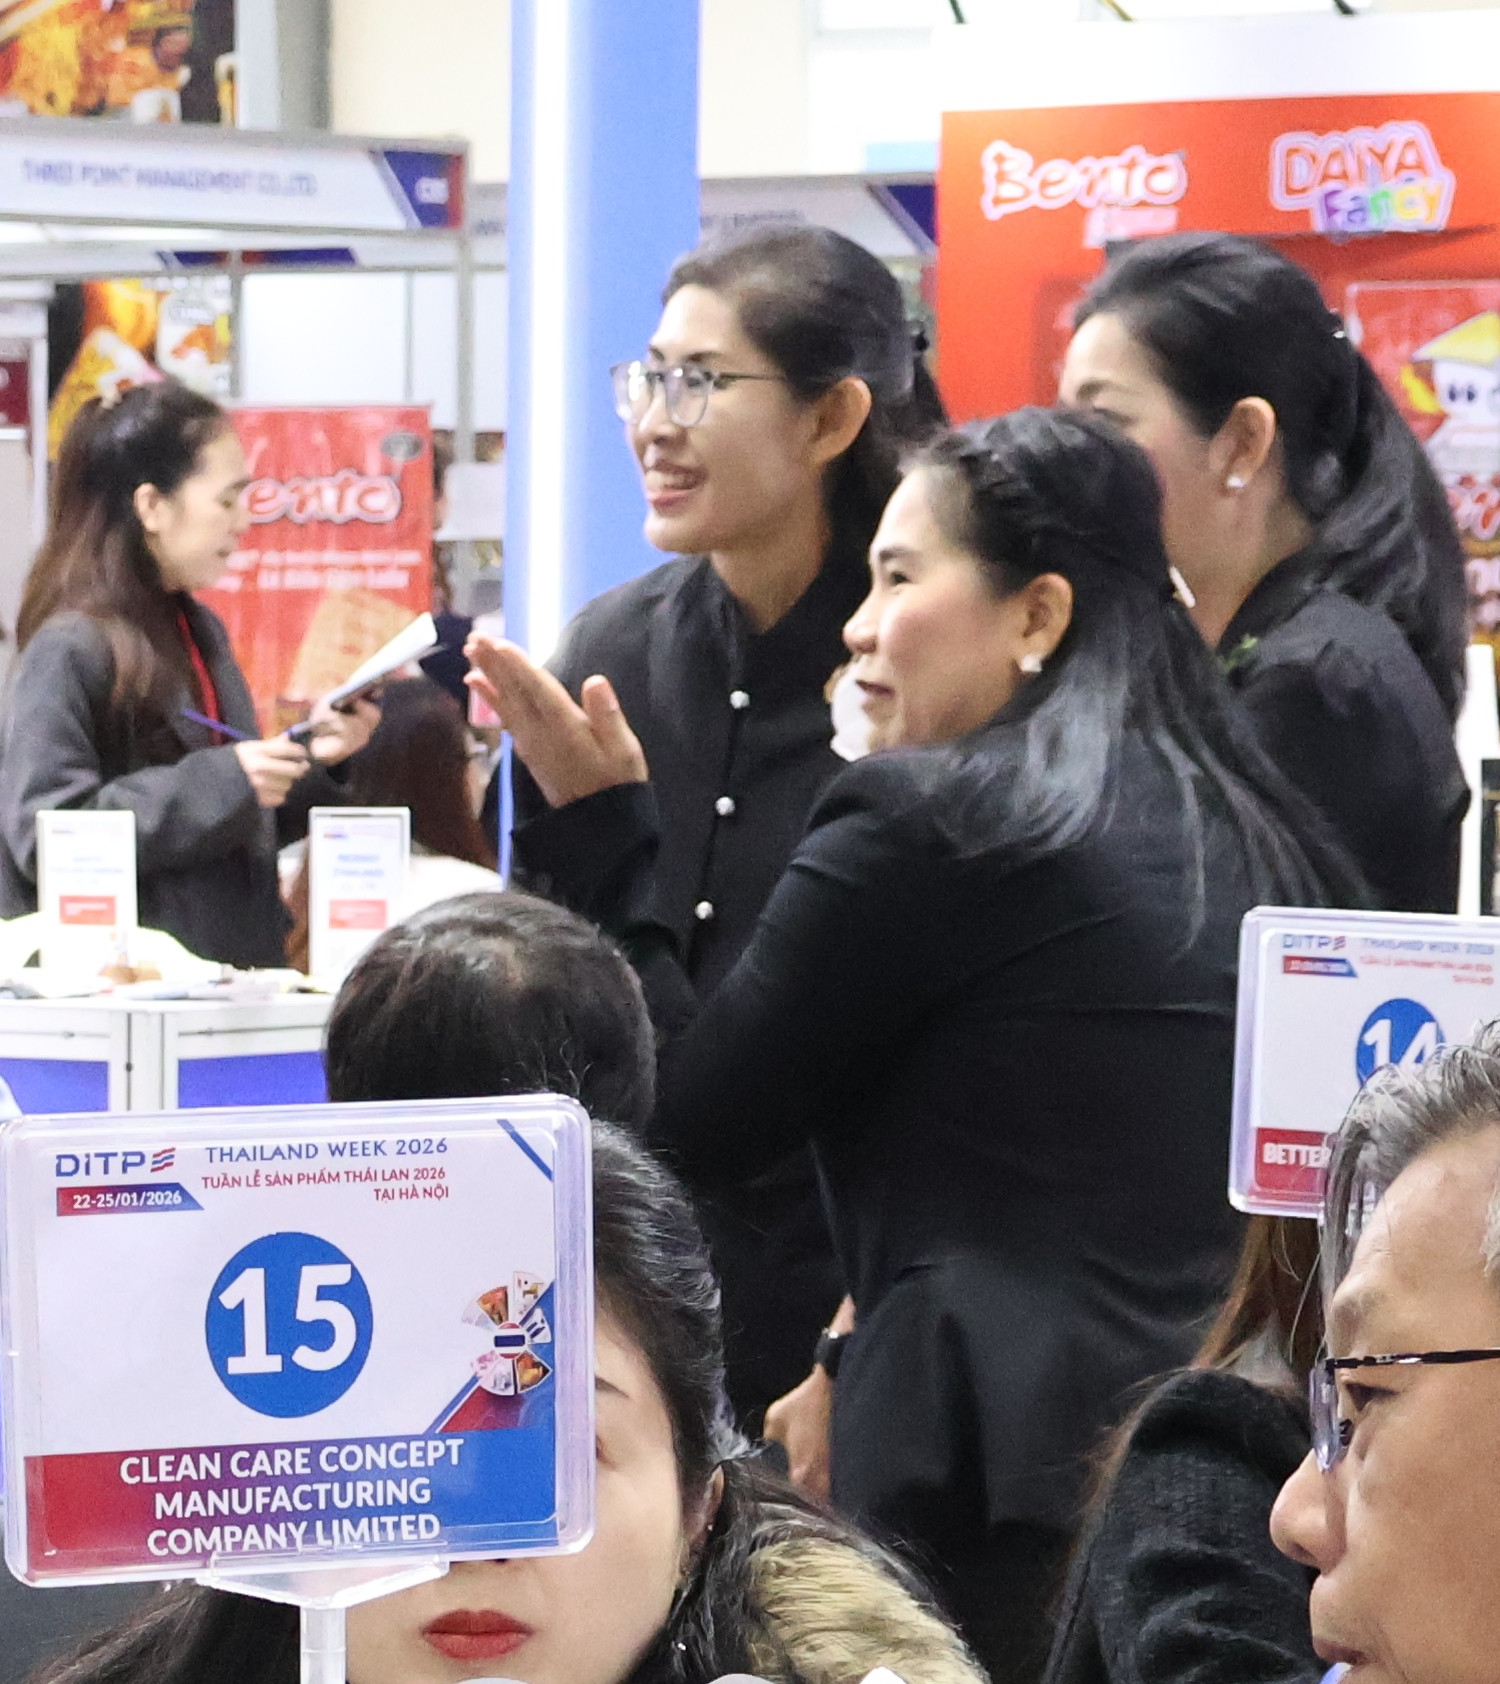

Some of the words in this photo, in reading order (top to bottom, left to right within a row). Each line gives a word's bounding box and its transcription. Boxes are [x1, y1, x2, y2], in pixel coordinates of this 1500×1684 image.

[205, 1143, 319, 1164] THAILAND
[328, 1140, 388, 1158] WEEK
[395, 1138, 448, 1156] 2026
[344, 1167, 378, 1183] THÁI
[382, 1169, 410, 1182] LAN
[414, 1168, 446, 1181] 2026
[374, 1187, 397, 1203] TẠI
[400, 1184, 420, 1201] HÀ
[423, 1181, 449, 1201] NỘI
[73, 1191, 183, 1210] 22-25/01/2026
[218, 1264, 358, 1375] 15
[120, 1453, 221, 1485] CLEAN
[230, 1447, 311, 1478] CARE
[319, 1438, 465, 1471] CONCEPT
[155, 1477, 432, 1519] MANUFACTURING
[147, 1521, 305, 1556] COMPANY
[315, 1513, 441, 1547] LIMITED
